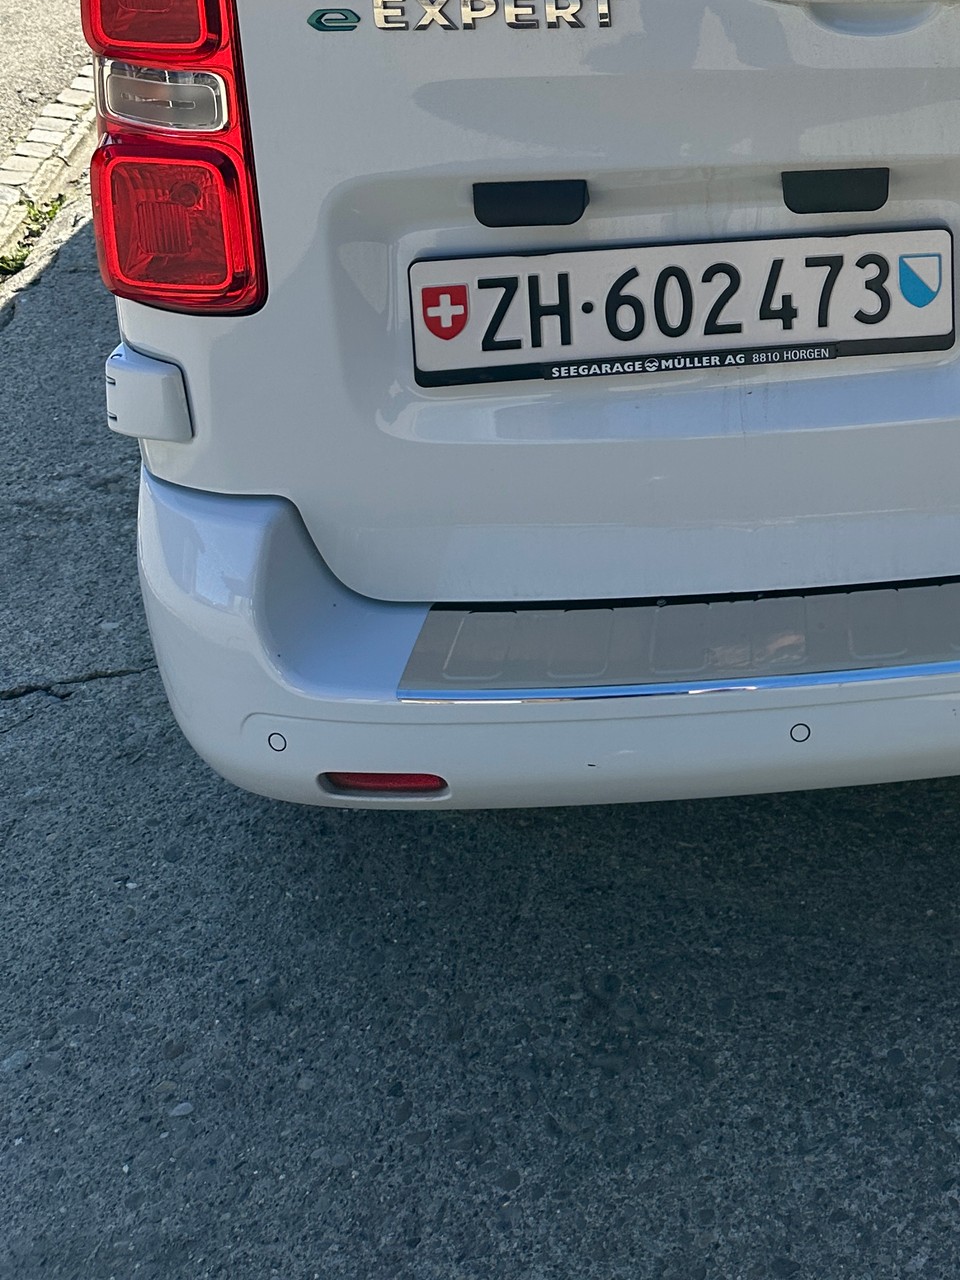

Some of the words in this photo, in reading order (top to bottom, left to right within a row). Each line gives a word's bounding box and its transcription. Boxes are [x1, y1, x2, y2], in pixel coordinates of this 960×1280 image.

[551, 360, 643, 377] SEEGARAGE
[661, 355, 721, 370] MÜLLER
[724, 353, 746, 365] AG
[752, 351, 780, 363] 8810
[783, 348, 830, 361] HORGEN
